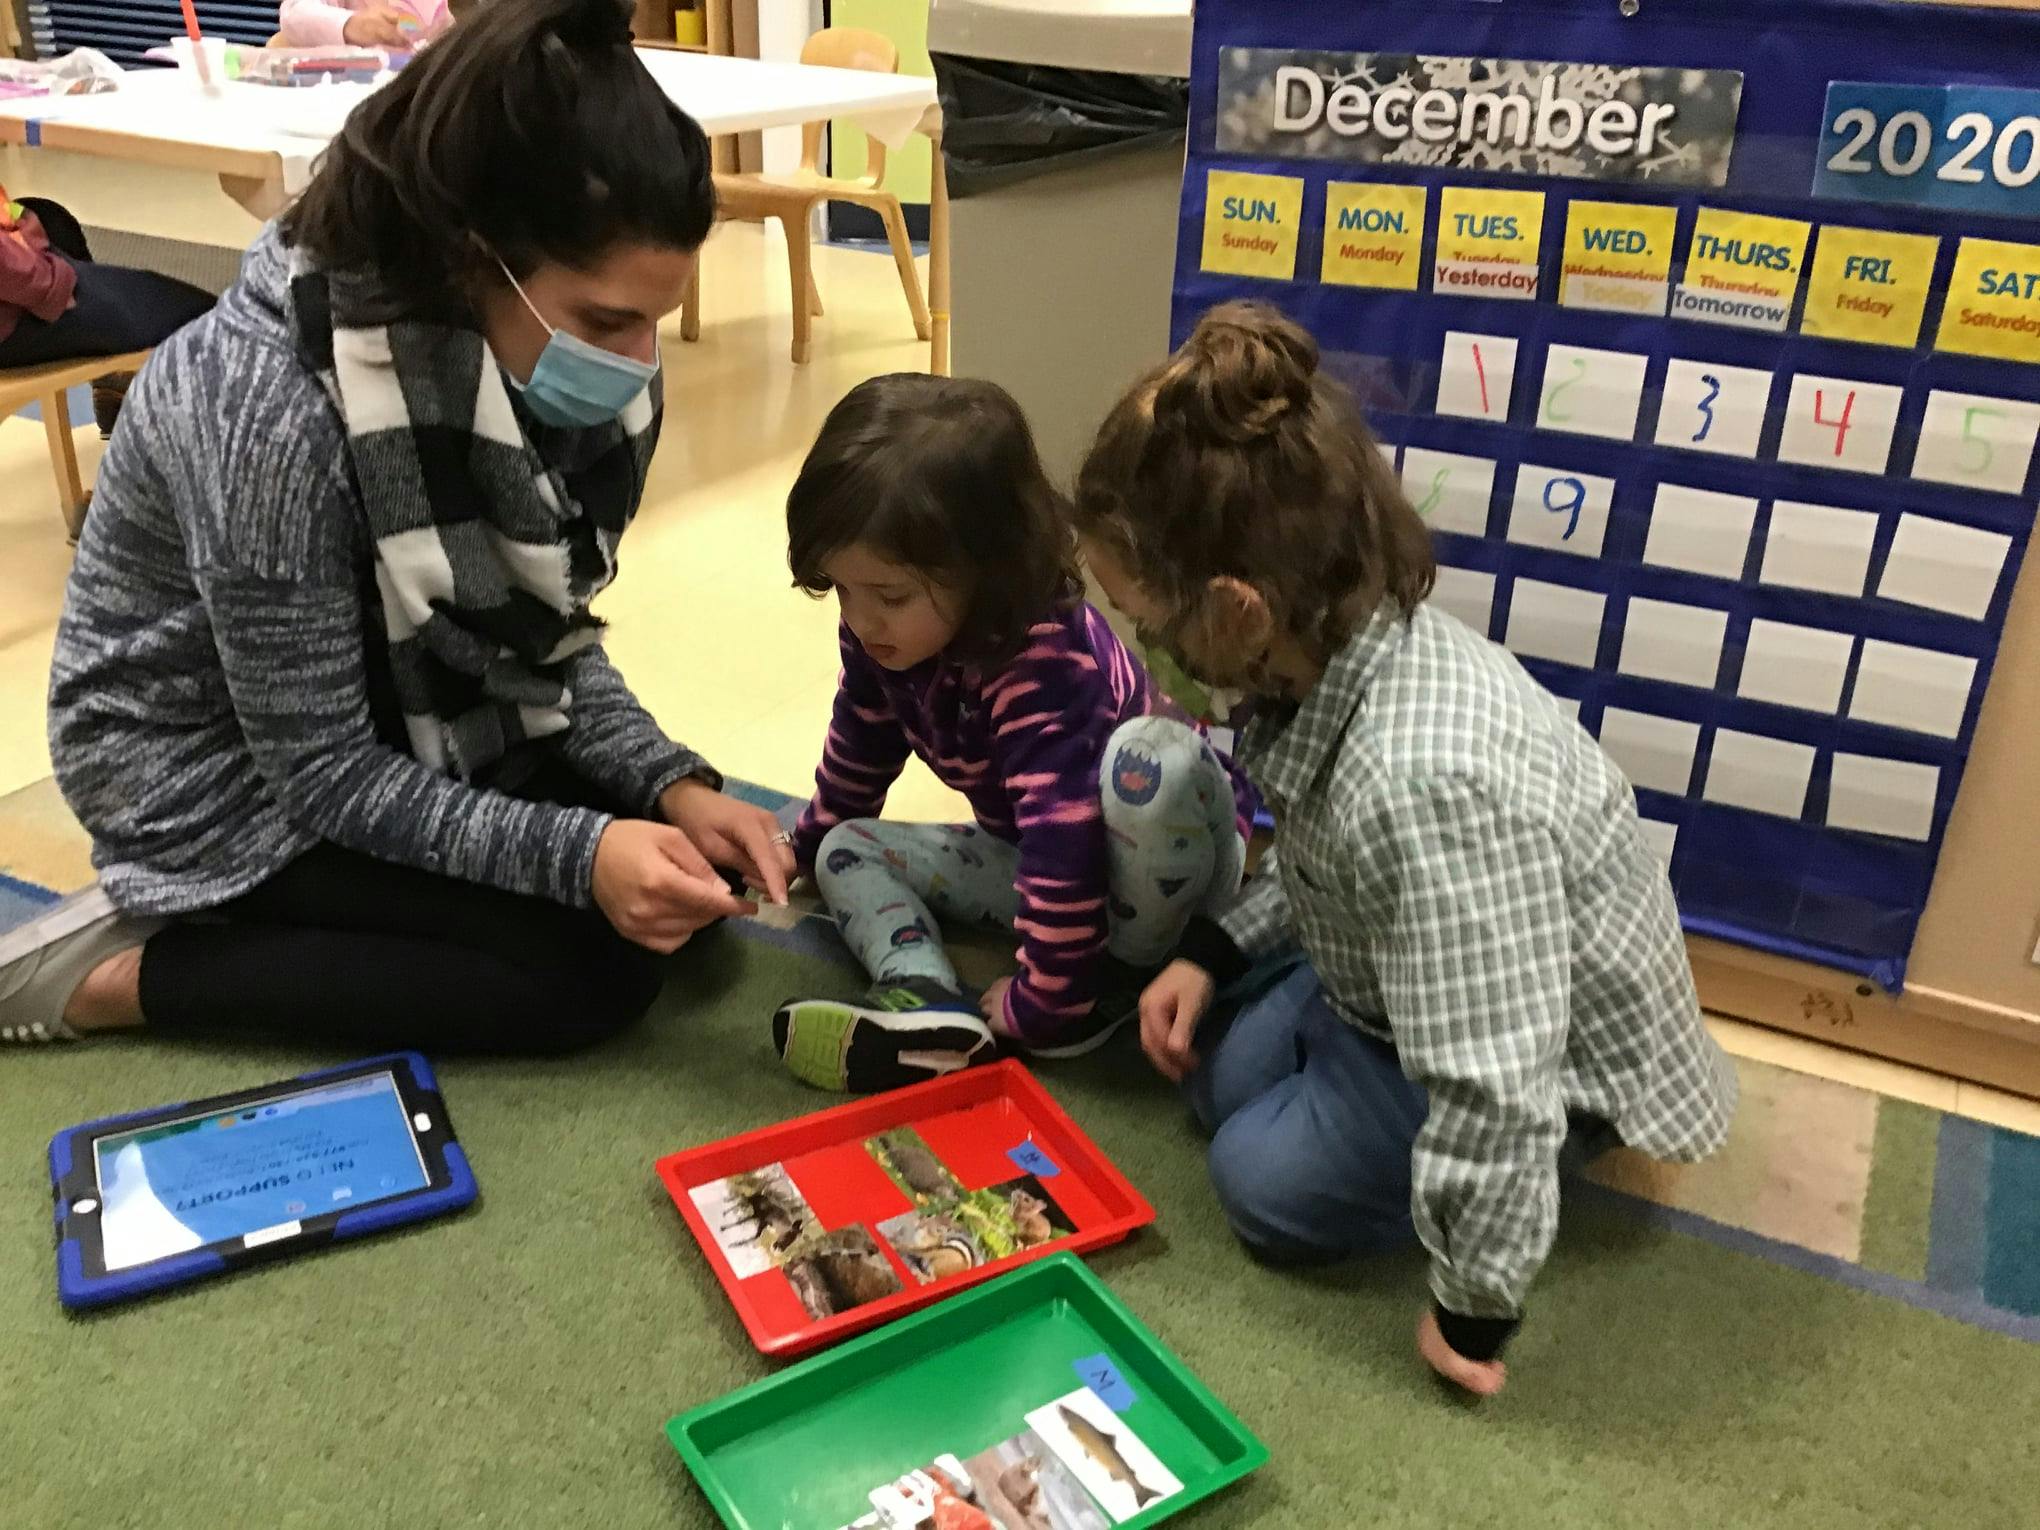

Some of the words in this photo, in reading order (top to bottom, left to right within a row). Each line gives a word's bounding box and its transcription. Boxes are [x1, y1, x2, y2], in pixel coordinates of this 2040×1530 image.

[1272, 65, 1676, 155] December
[1826, 107, 2040, 188] 2020
[1222, 196, 1281, 224] SUN.
[1337, 206, 1409, 234] MON.
[1454, 213, 1524, 241] TUES.
[1221, 232, 1279, 256] Sunday
[1339, 243, 1404, 266] Monday
[1583, 227, 1653, 256] WED.
[1697, 234, 1797, 274] THURS.
[1437, 264, 1539, 294] Yesterday
[1843, 255, 1897, 285] FRI.
[1674, 289, 1786, 323] Tomorrow
[1836, 293, 1894, 319] Friday
[1471, 342, 1489, 415] 1
[1545, 357, 1587, 423] 2
[1691, 373, 1721, 442] 3
[1813, 389, 1857, 457] 4
[1955, 407, 2008, 474] 5
[1542, 476, 1587, 541] 9
